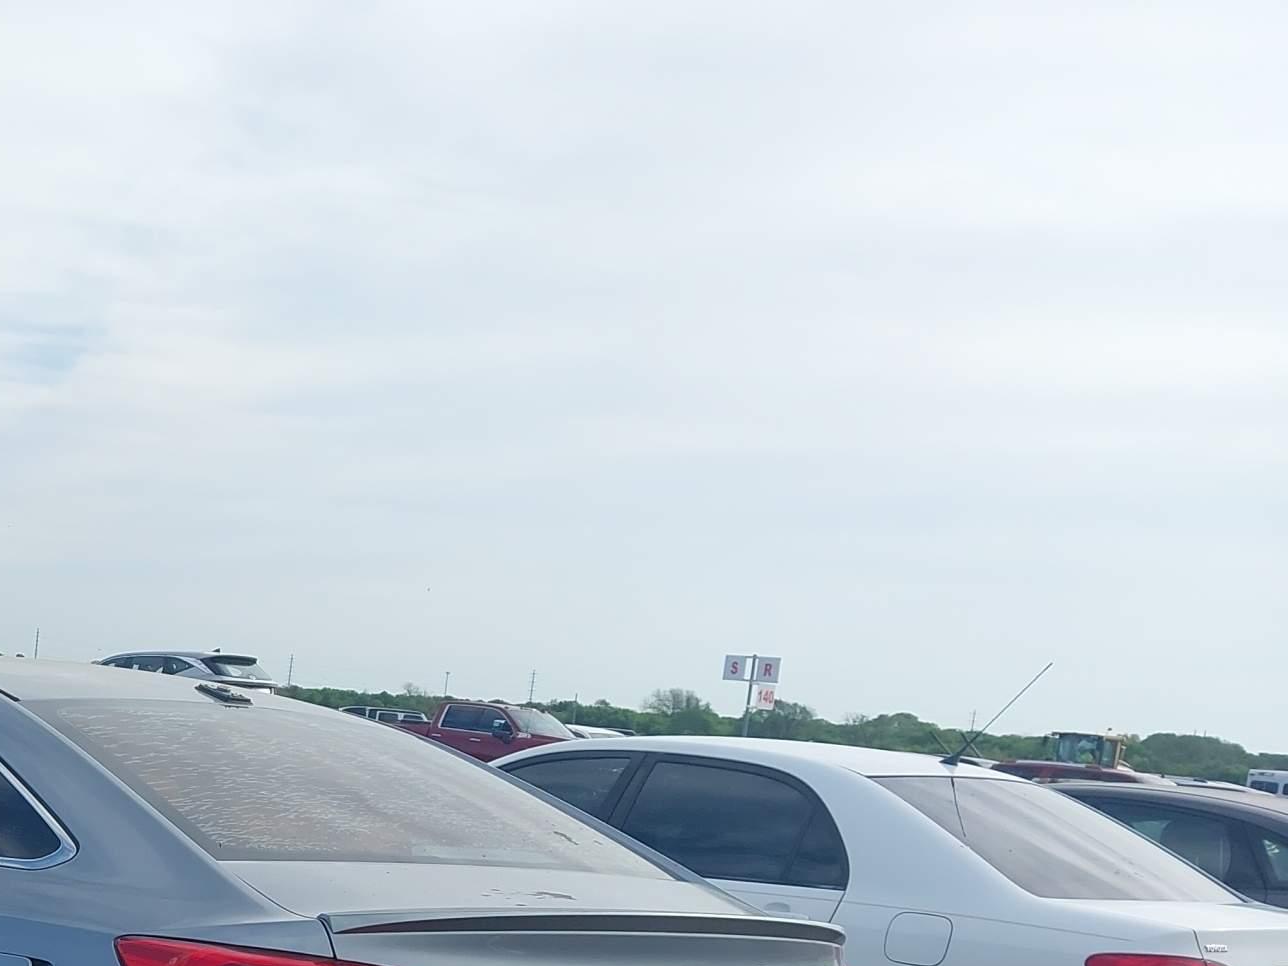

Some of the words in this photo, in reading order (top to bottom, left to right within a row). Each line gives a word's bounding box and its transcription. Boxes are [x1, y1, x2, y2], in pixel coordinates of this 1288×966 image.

[731, 661, 738, 674] S
[764, 663, 772, 677] R
[757, 688, 774, 704] 140
